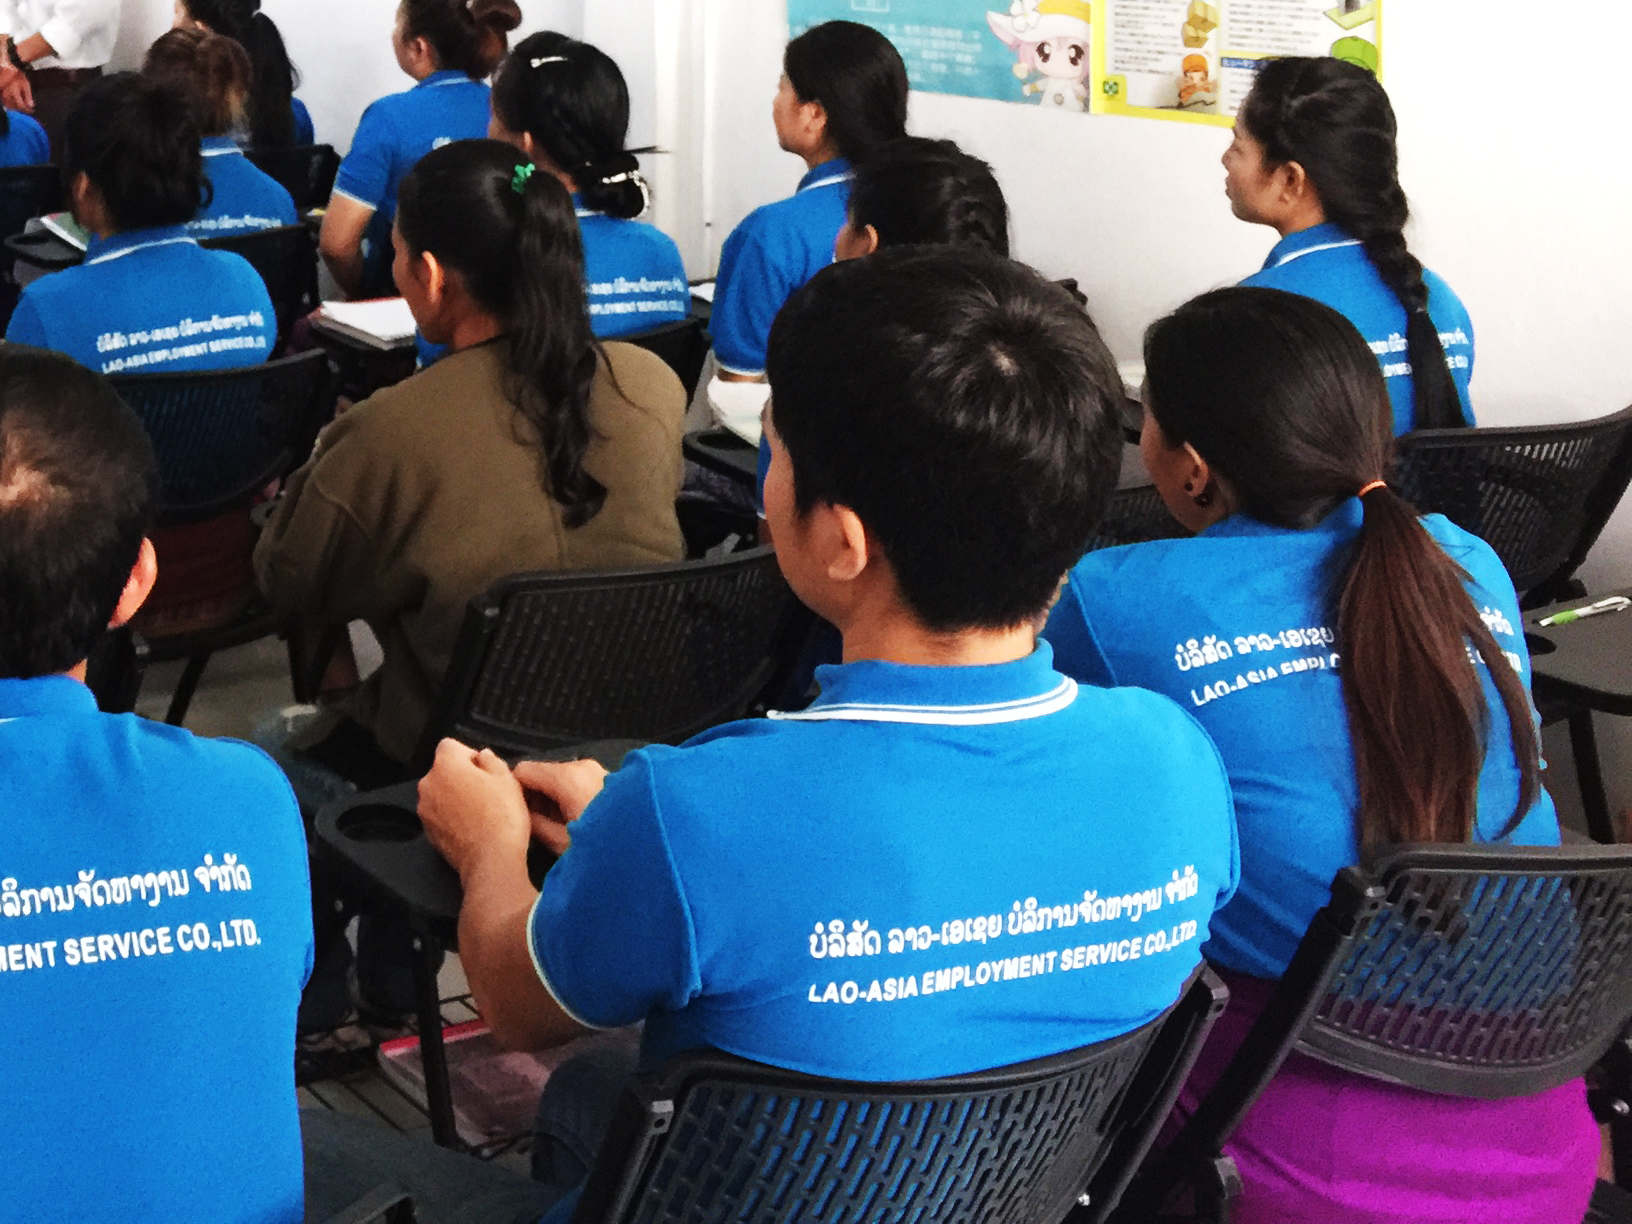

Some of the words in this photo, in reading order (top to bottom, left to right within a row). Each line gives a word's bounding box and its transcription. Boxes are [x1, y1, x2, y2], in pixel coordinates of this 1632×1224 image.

[64, 926, 174, 966] SERVICE
[177, 918, 262, 953] CO.,LTD.
[808, 975, 919, 1005] LAO-ASIA
[922, 951, 1058, 995] EMPLOYMENT
[1060, 937, 1143, 972] SERVICE
